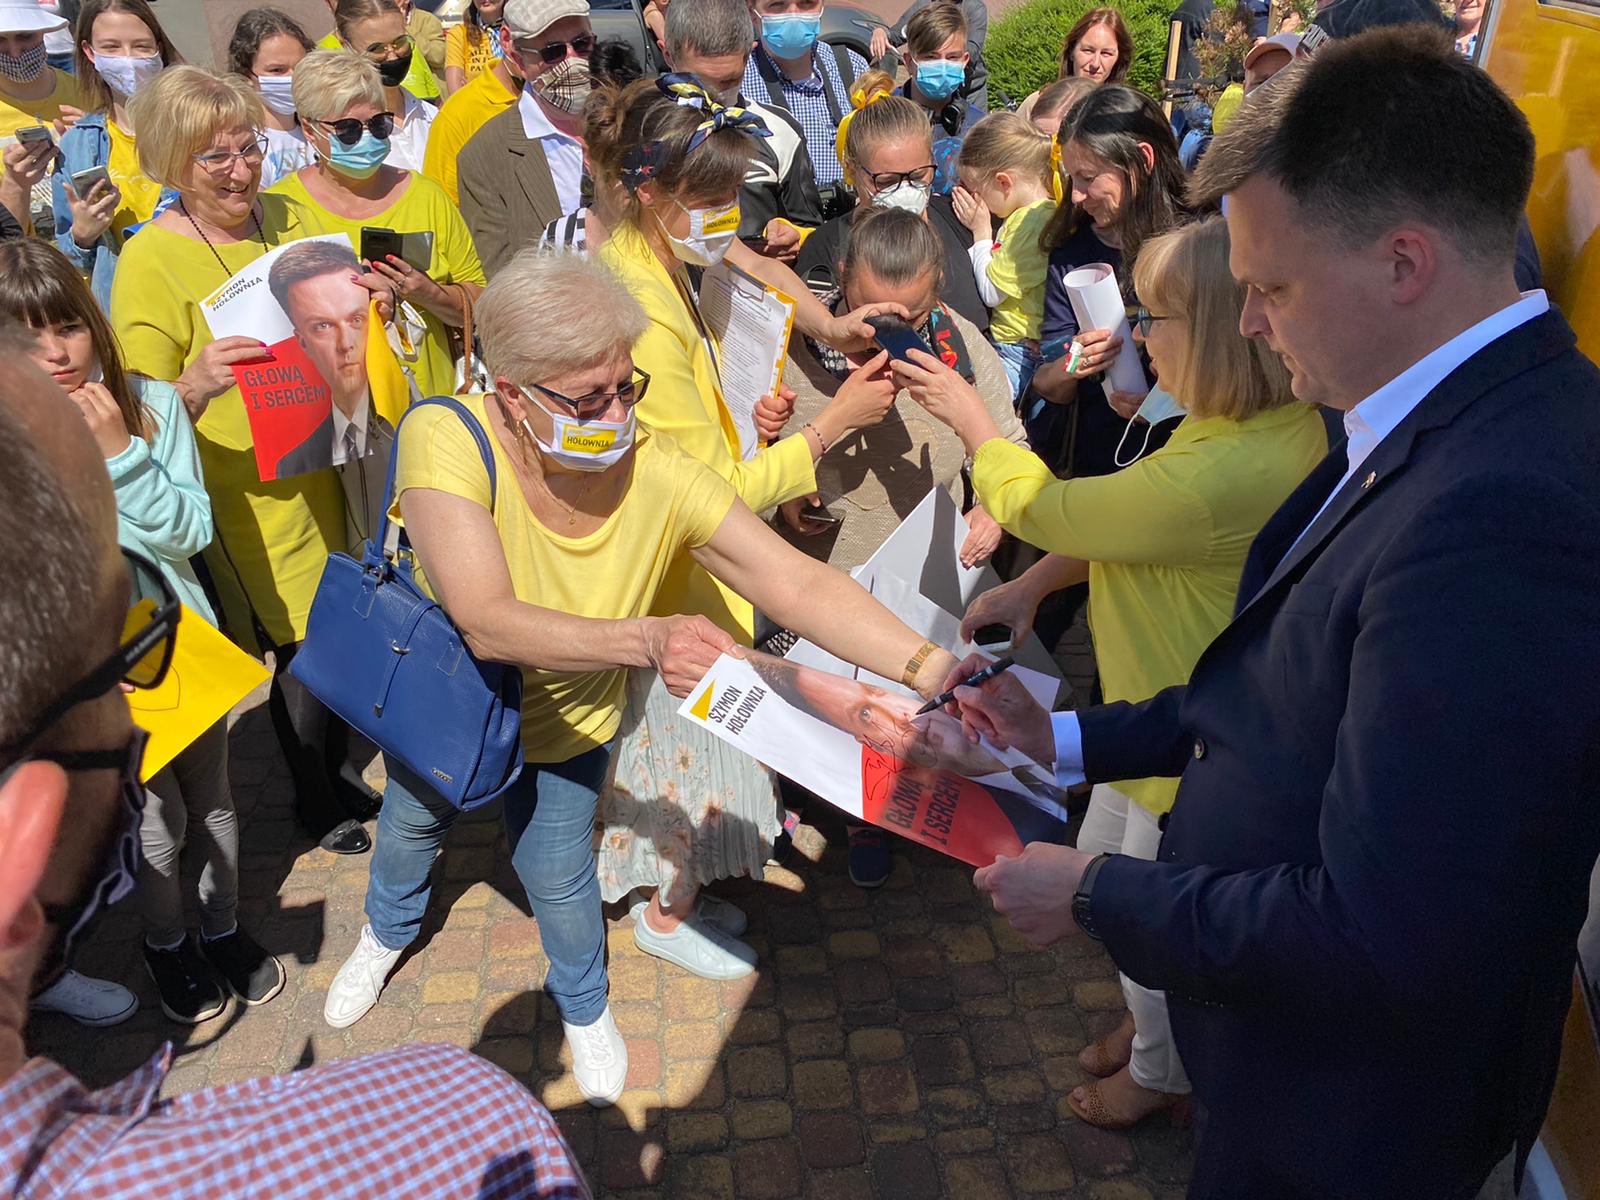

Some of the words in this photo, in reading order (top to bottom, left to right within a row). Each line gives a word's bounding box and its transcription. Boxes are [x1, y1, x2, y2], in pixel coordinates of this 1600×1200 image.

[212, 276, 263, 311] HOŁOWNIA
[243, 365, 306, 387] GŁOWĄ
[251, 392, 261, 409] I
[264, 385, 326, 408] SERCEM
[708, 685, 742, 723] SZYMON
[725, 685, 767, 736] HOŁOWNIA
[885, 772, 933, 829] GŁOWĄ
[923, 774, 961, 834] SERCEM
[921, 829, 948, 846] I
